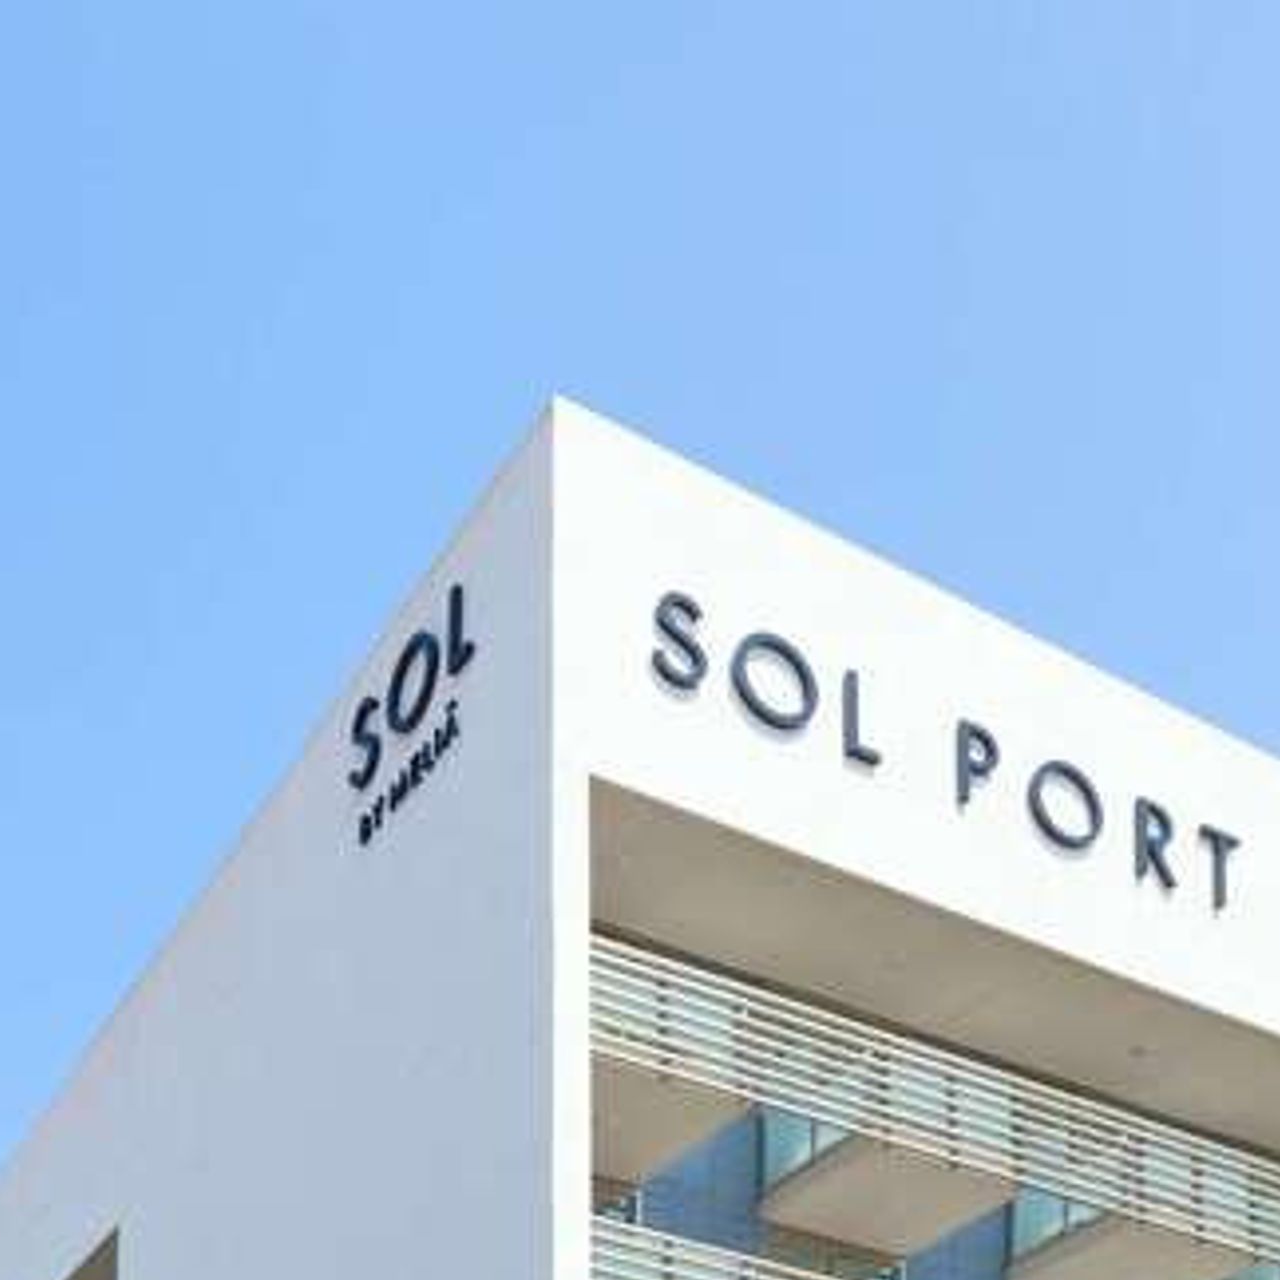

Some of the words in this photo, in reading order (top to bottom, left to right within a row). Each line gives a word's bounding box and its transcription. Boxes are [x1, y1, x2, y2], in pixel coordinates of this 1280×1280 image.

[348, 583, 475, 792] SOL
[651, 590, 882, 768] SOL
[955, 718, 1241, 911] PORT
[359, 795, 384, 846] BY
